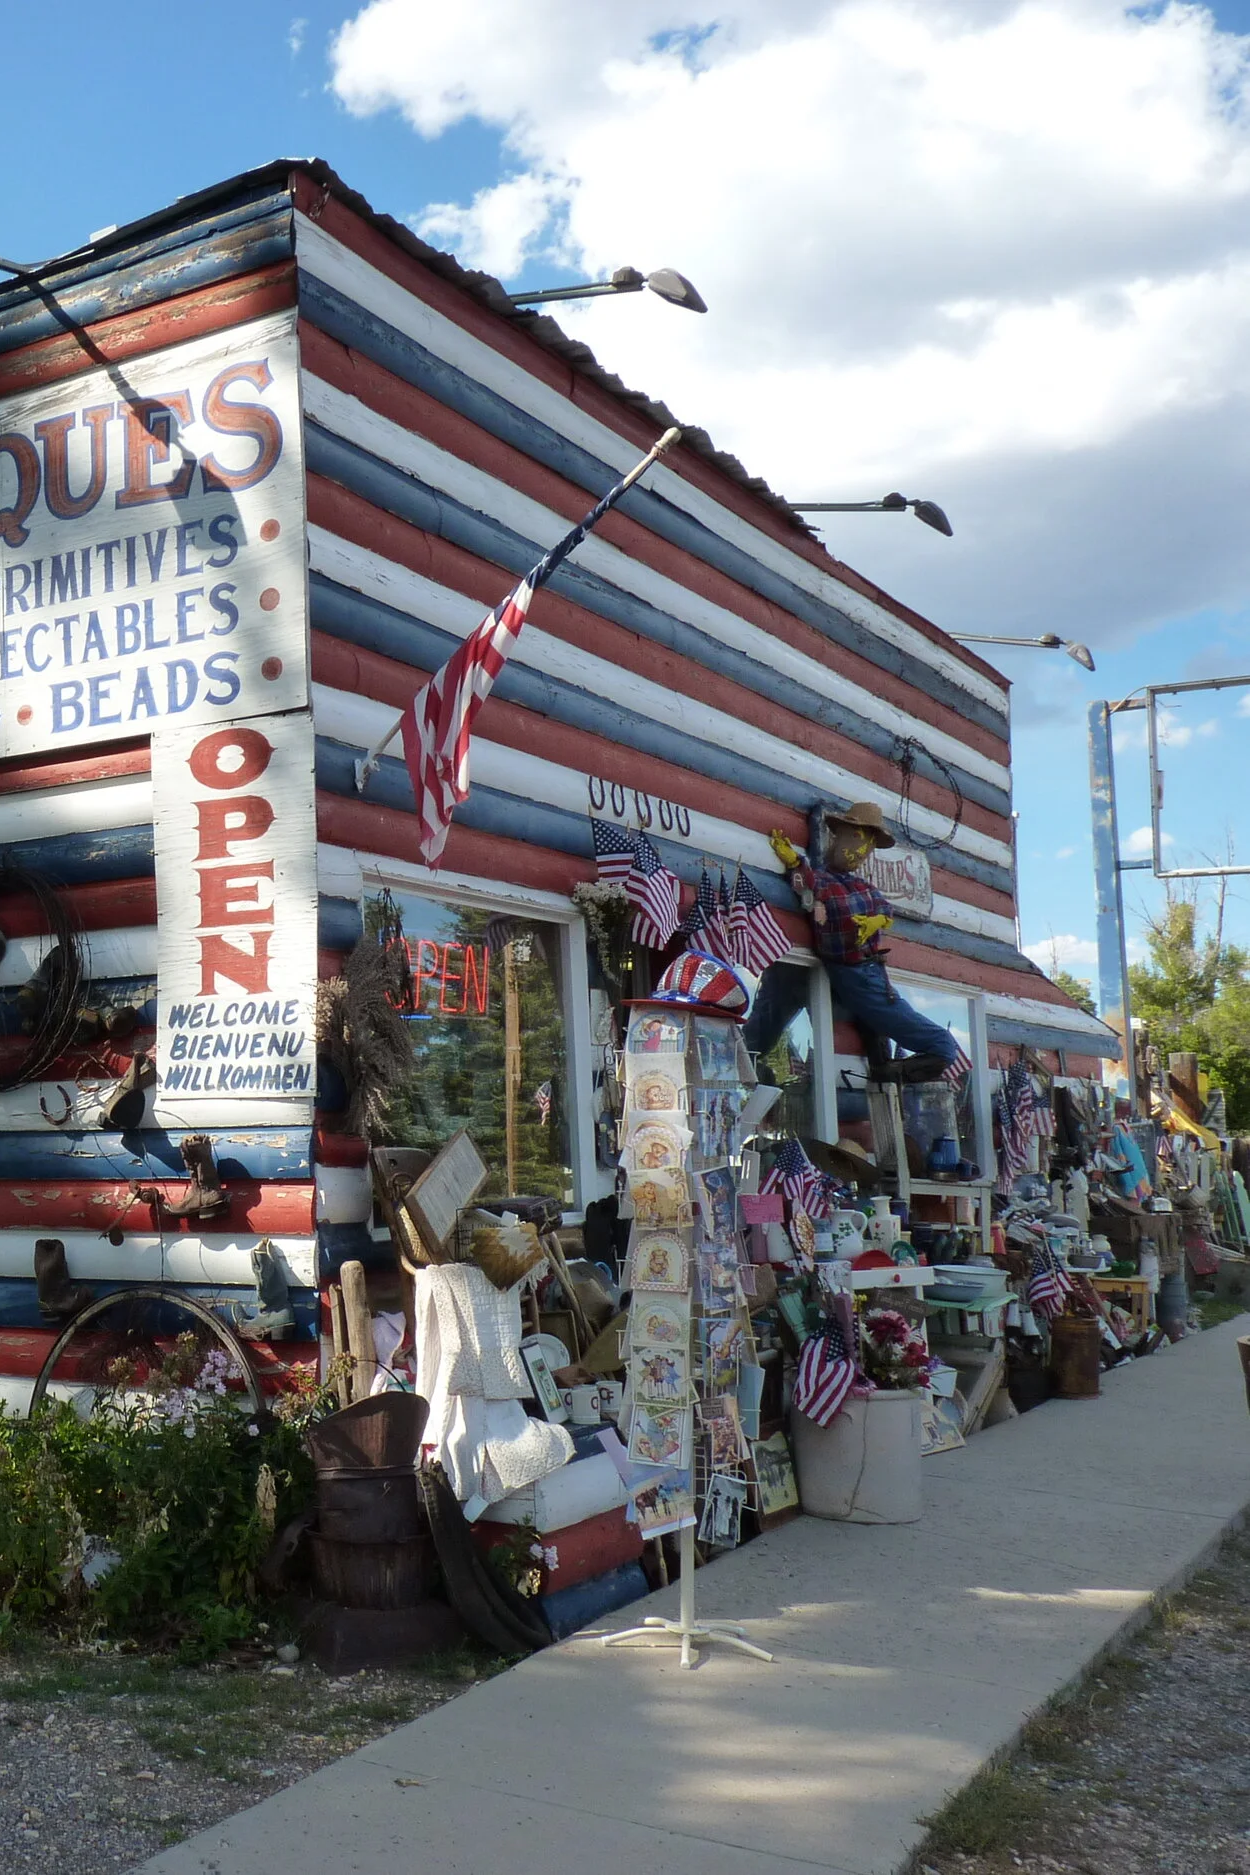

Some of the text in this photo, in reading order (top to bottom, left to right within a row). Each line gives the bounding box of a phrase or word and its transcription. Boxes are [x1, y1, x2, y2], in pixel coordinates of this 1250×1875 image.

[49, 651, 242, 735] BEADS
[184, 727, 277, 997] OPEN
[168, 998, 299, 1029] WELCOME
[169, 1030, 306, 1061] BIENVENU
[163, 1062, 312, 1092] WILLKOMMEN
